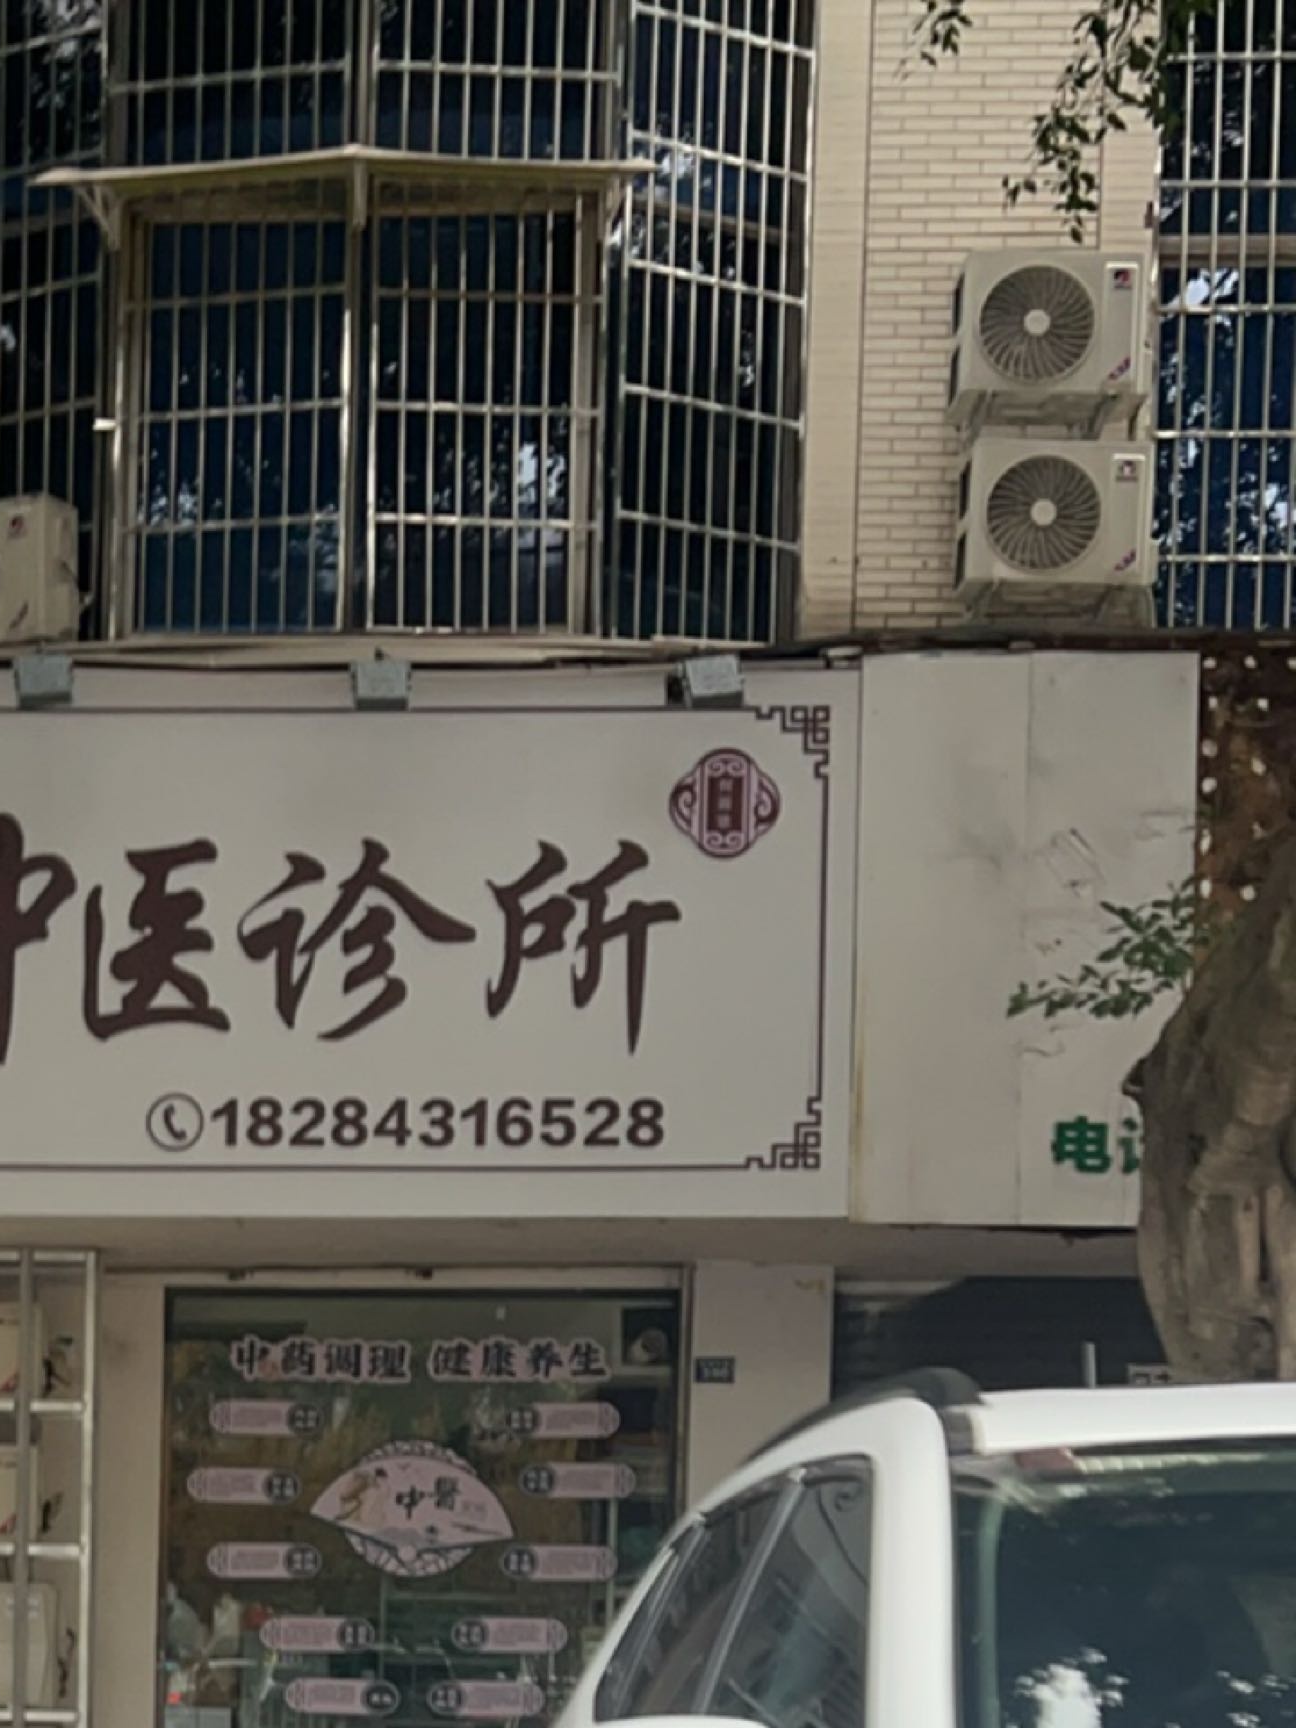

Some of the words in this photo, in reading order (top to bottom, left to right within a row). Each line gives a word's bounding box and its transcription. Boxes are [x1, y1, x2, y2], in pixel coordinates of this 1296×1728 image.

[209, 1096, 665, 1149] 18284316528
[231, 1333, 411, 1382] 中药调理
[428, 1336, 611, 1383] 健康养生
